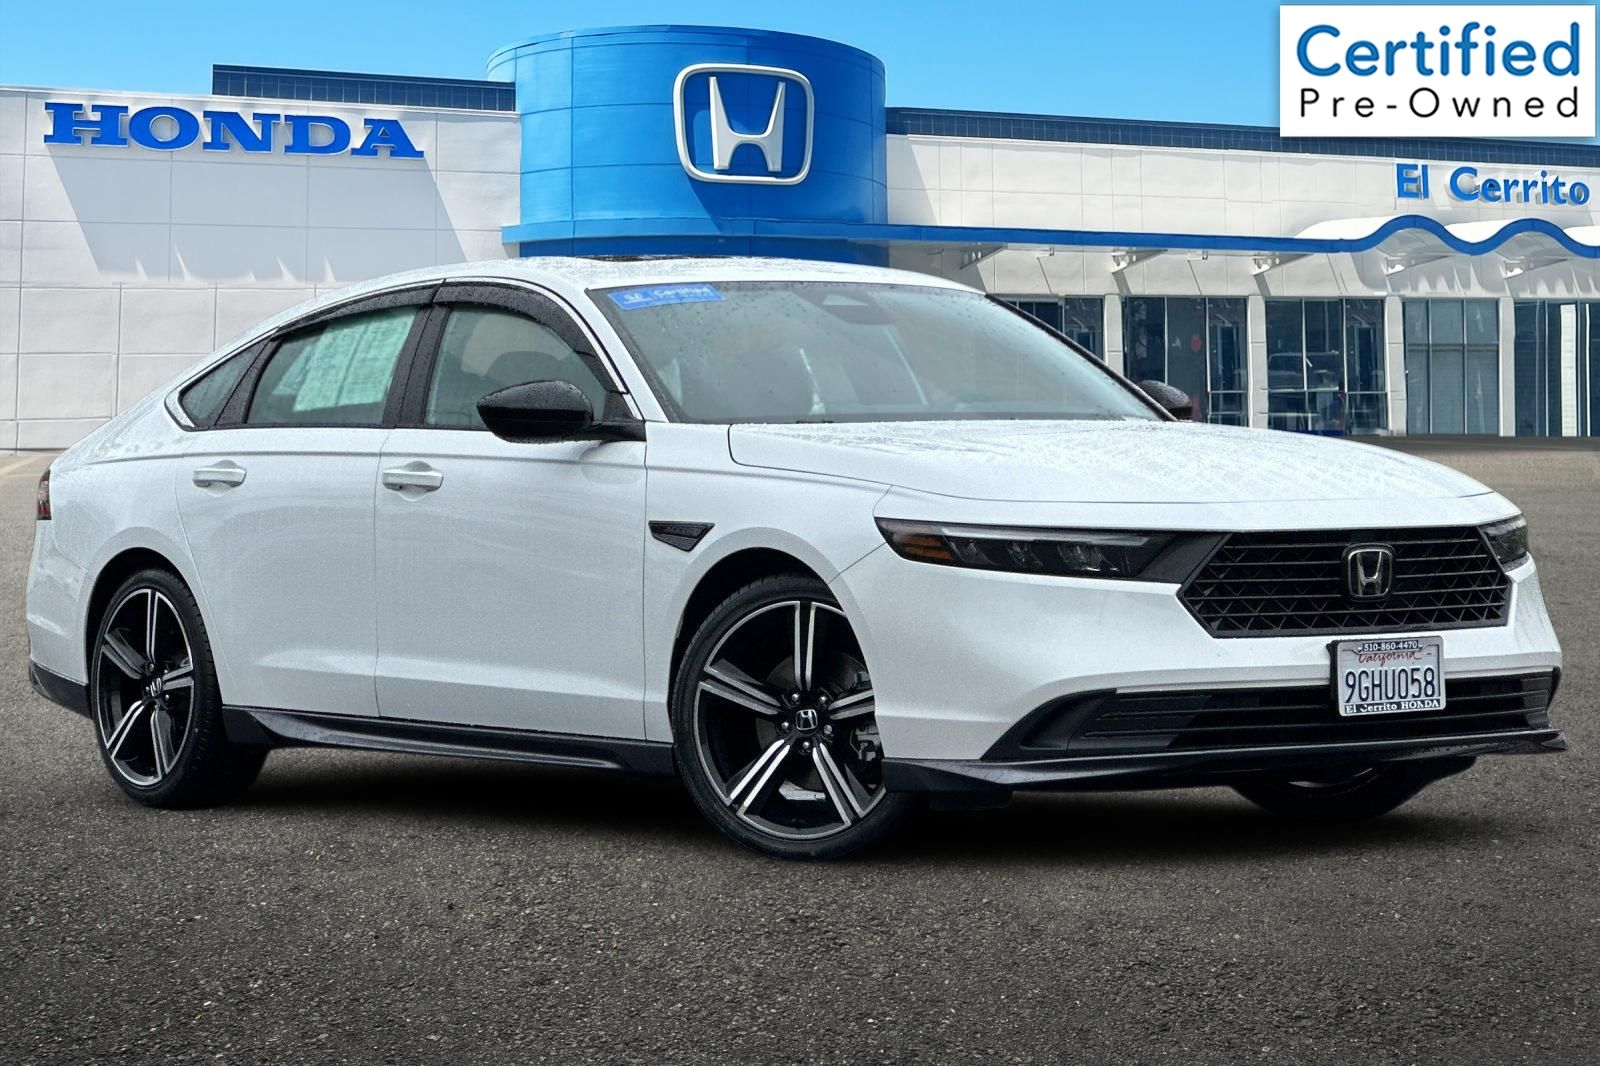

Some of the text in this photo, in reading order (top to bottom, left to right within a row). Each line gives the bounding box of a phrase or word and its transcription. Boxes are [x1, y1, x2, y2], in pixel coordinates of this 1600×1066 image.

[44, 101, 425, 159] HONDA
[1396, 162, 1590, 206] El Cerrito
[1364, 641, 1418, 652] 510-860-4470
[1345, 667, 1436, 703] 9GHU058
[1345, 704, 1357, 714] El
[1400, 699, 1440, 710] HONDA
